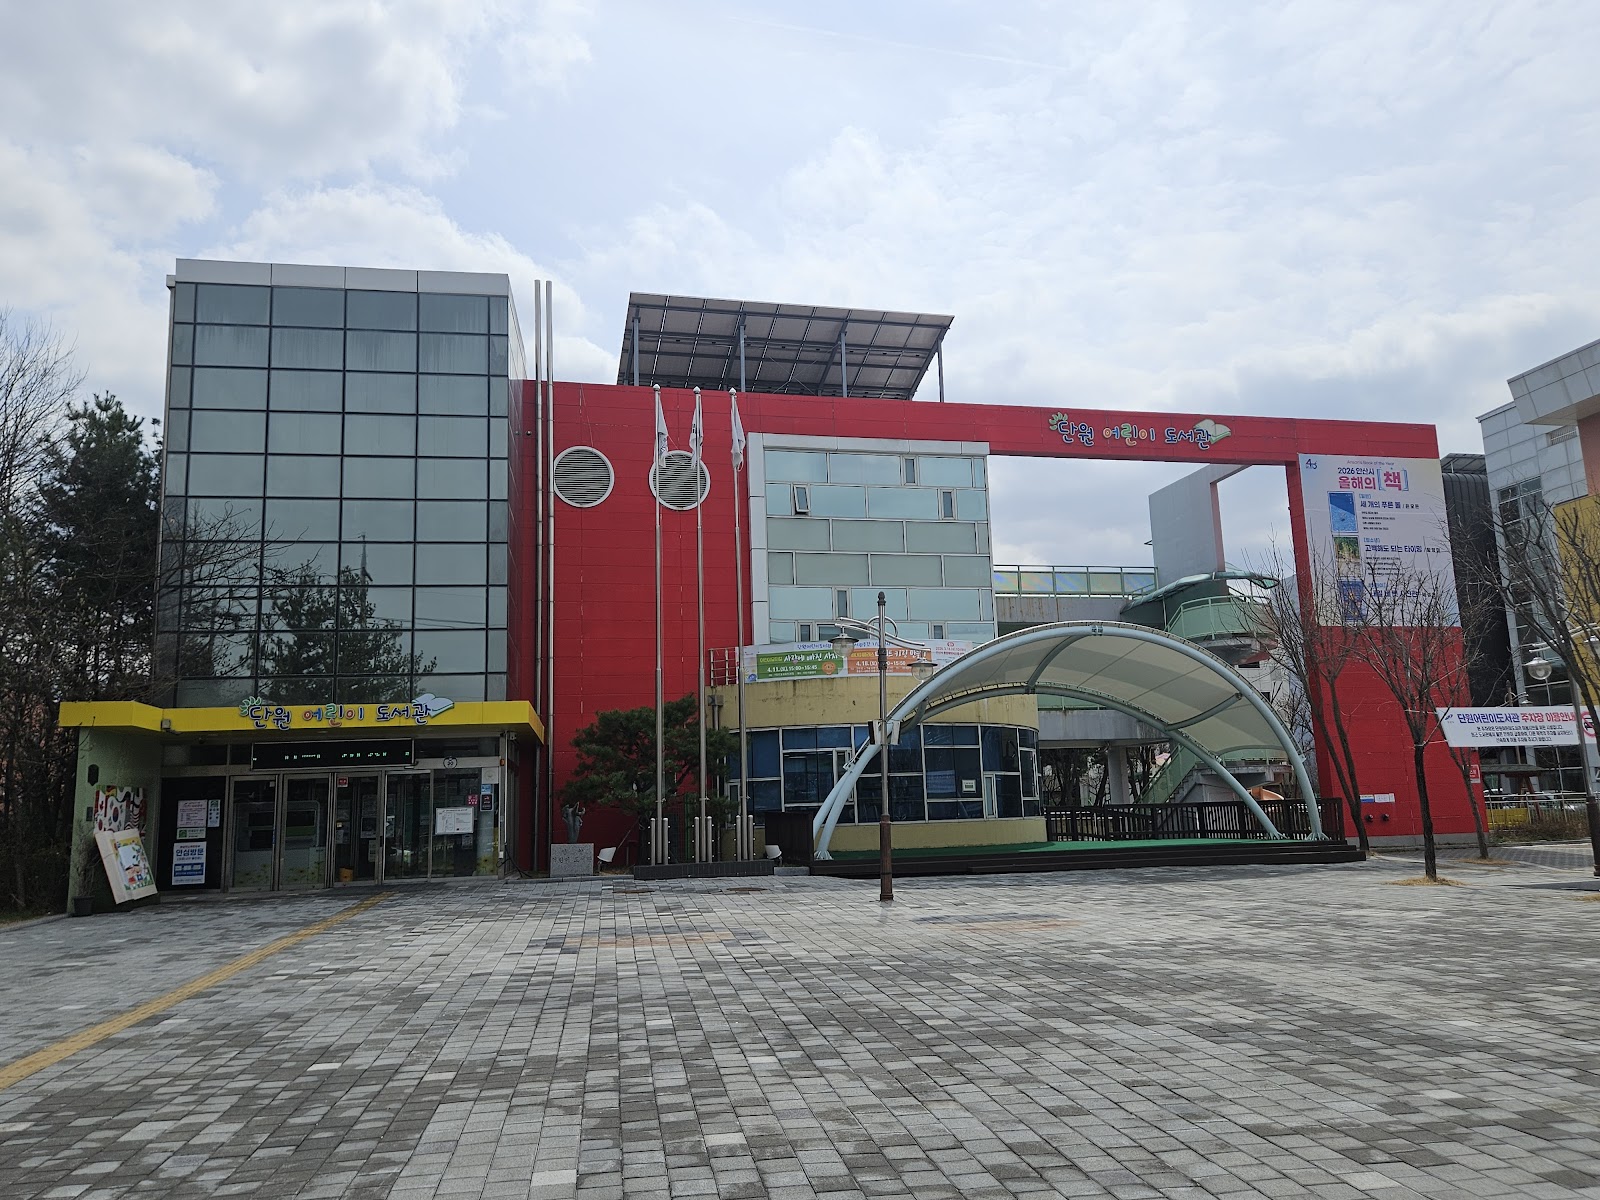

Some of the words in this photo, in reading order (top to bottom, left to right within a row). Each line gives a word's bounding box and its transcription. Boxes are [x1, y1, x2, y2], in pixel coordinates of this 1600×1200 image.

[1058, 420, 1095, 447] 단원
[1102, 423, 1156, 446] 어린이
[1164, 427, 1211, 450] 도서관
[1338, 467, 1356, 475] 2026
[1356, 467, 1375, 475] 안산시
[1338, 476, 1376, 490] 올해의
[1361, 500, 1367, 508] 세
[1368, 500, 1380, 509] 개의
[1382, 501, 1394, 509] 푸른
[1390, 545, 1402, 553] 되는
[784, 654, 805, 663] 사랑에
[806, 653, 822, 662] 빠진
[248, 703, 291, 730] 단원
[302, 703, 363, 727] 어린이
[376, 702, 431, 725] 도서관
[1457, 712, 1521, 724] 단원어린이도서관
[1521, 711, 1545, 723] 주차장
[1546, 711, 1577, 722] 이용안내
